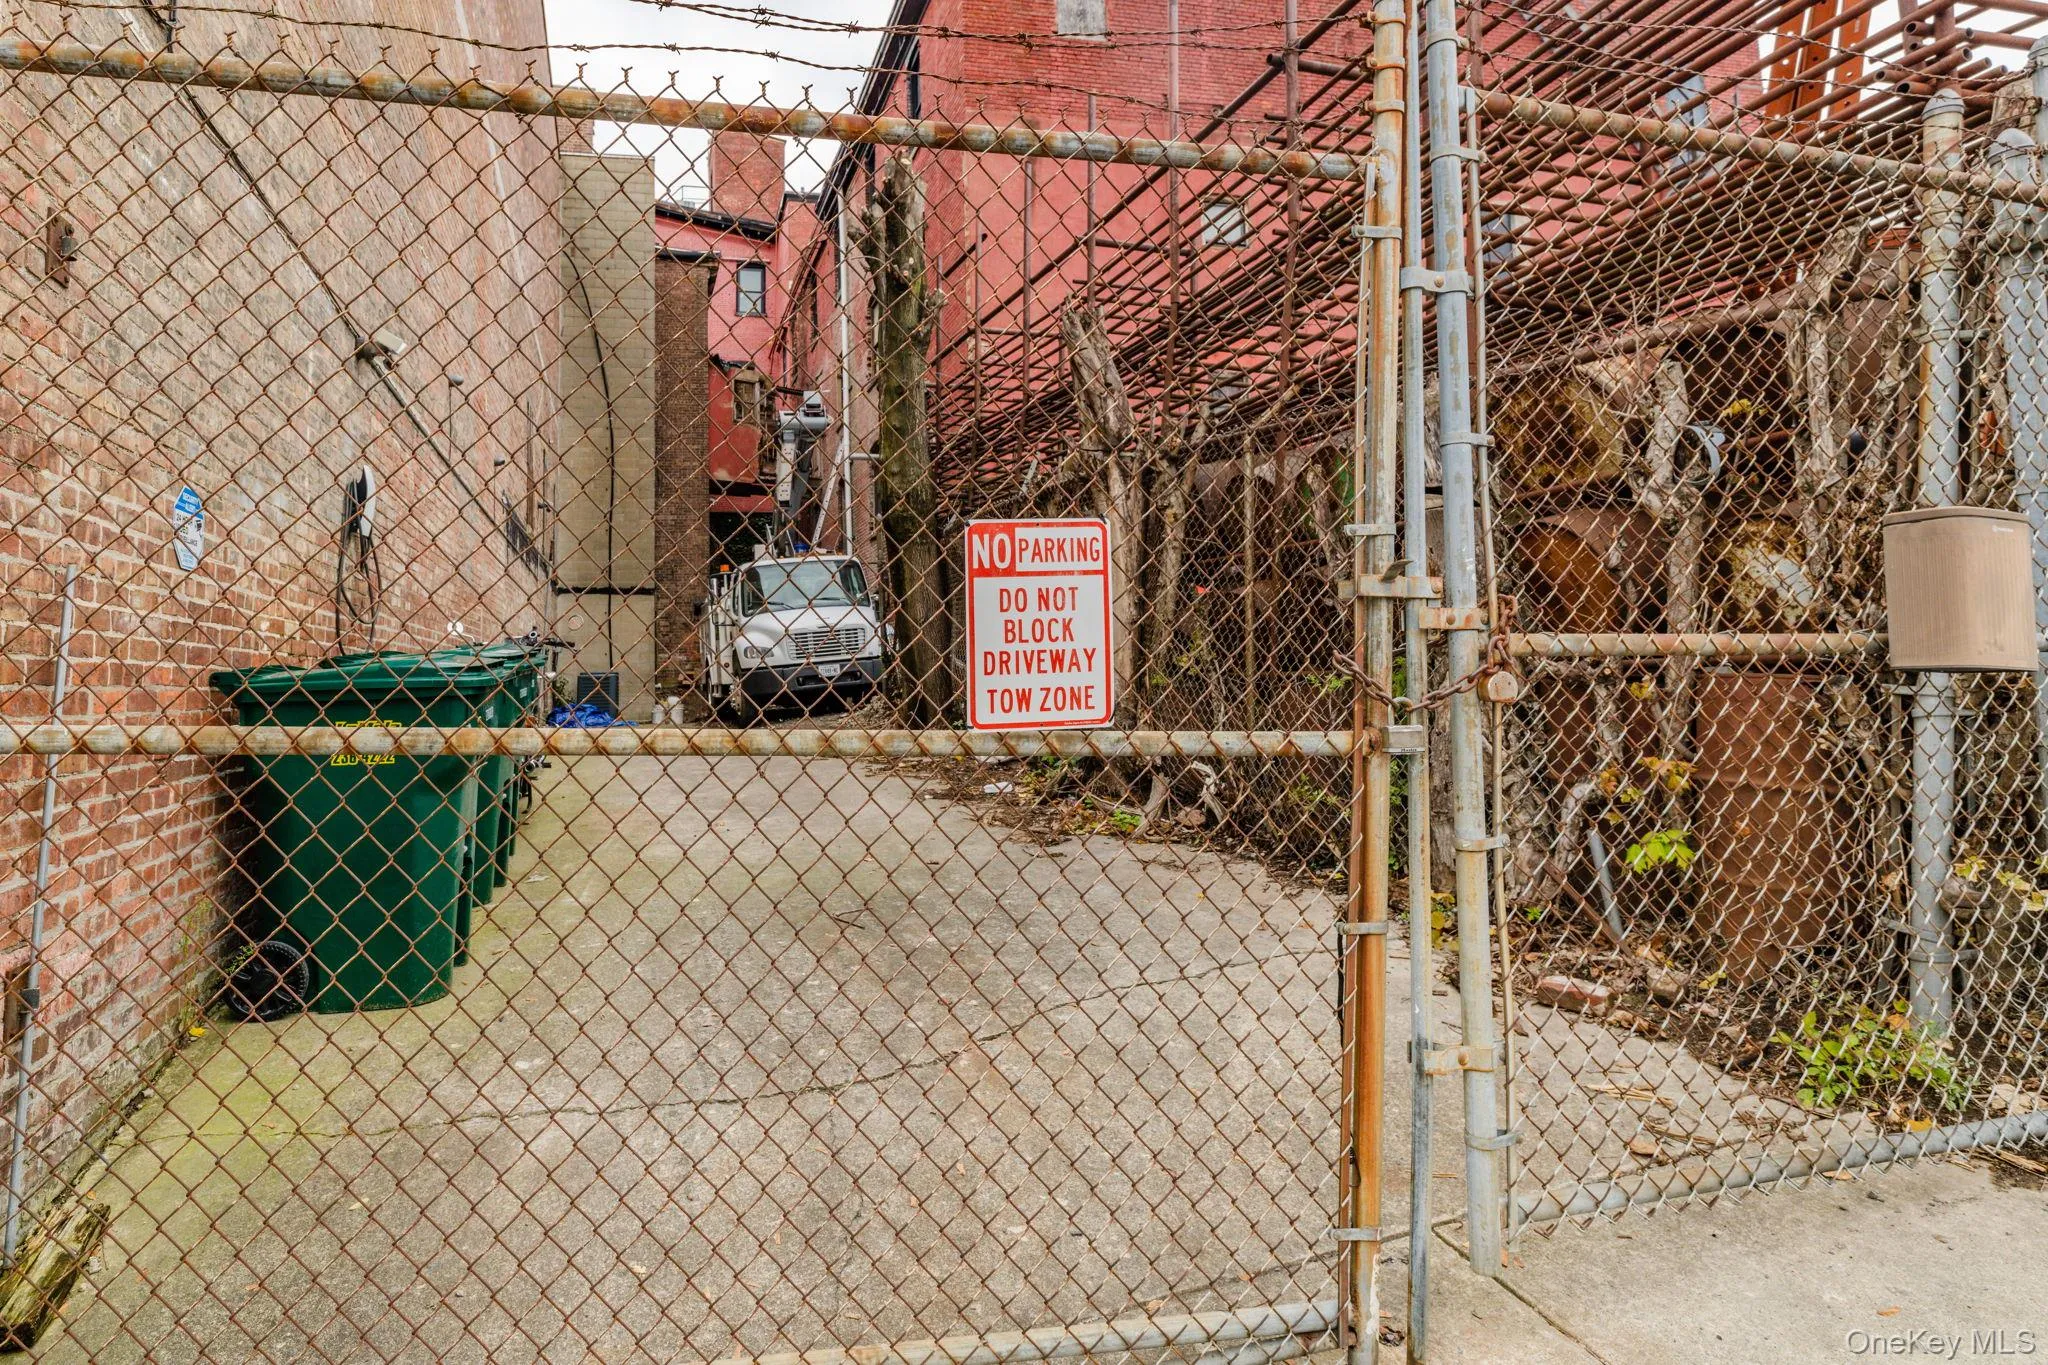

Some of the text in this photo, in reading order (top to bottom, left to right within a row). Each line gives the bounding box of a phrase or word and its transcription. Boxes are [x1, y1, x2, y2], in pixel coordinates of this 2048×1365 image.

[971, 533, 1101, 570] NO PARKING
[999, 586, 1079, 613] DO NOT
[1003, 617, 1075, 644] BLOCK
[983, 647, 1097, 676] DRIVEWAY
[986, 685, 1096, 714] TOW ZONE
